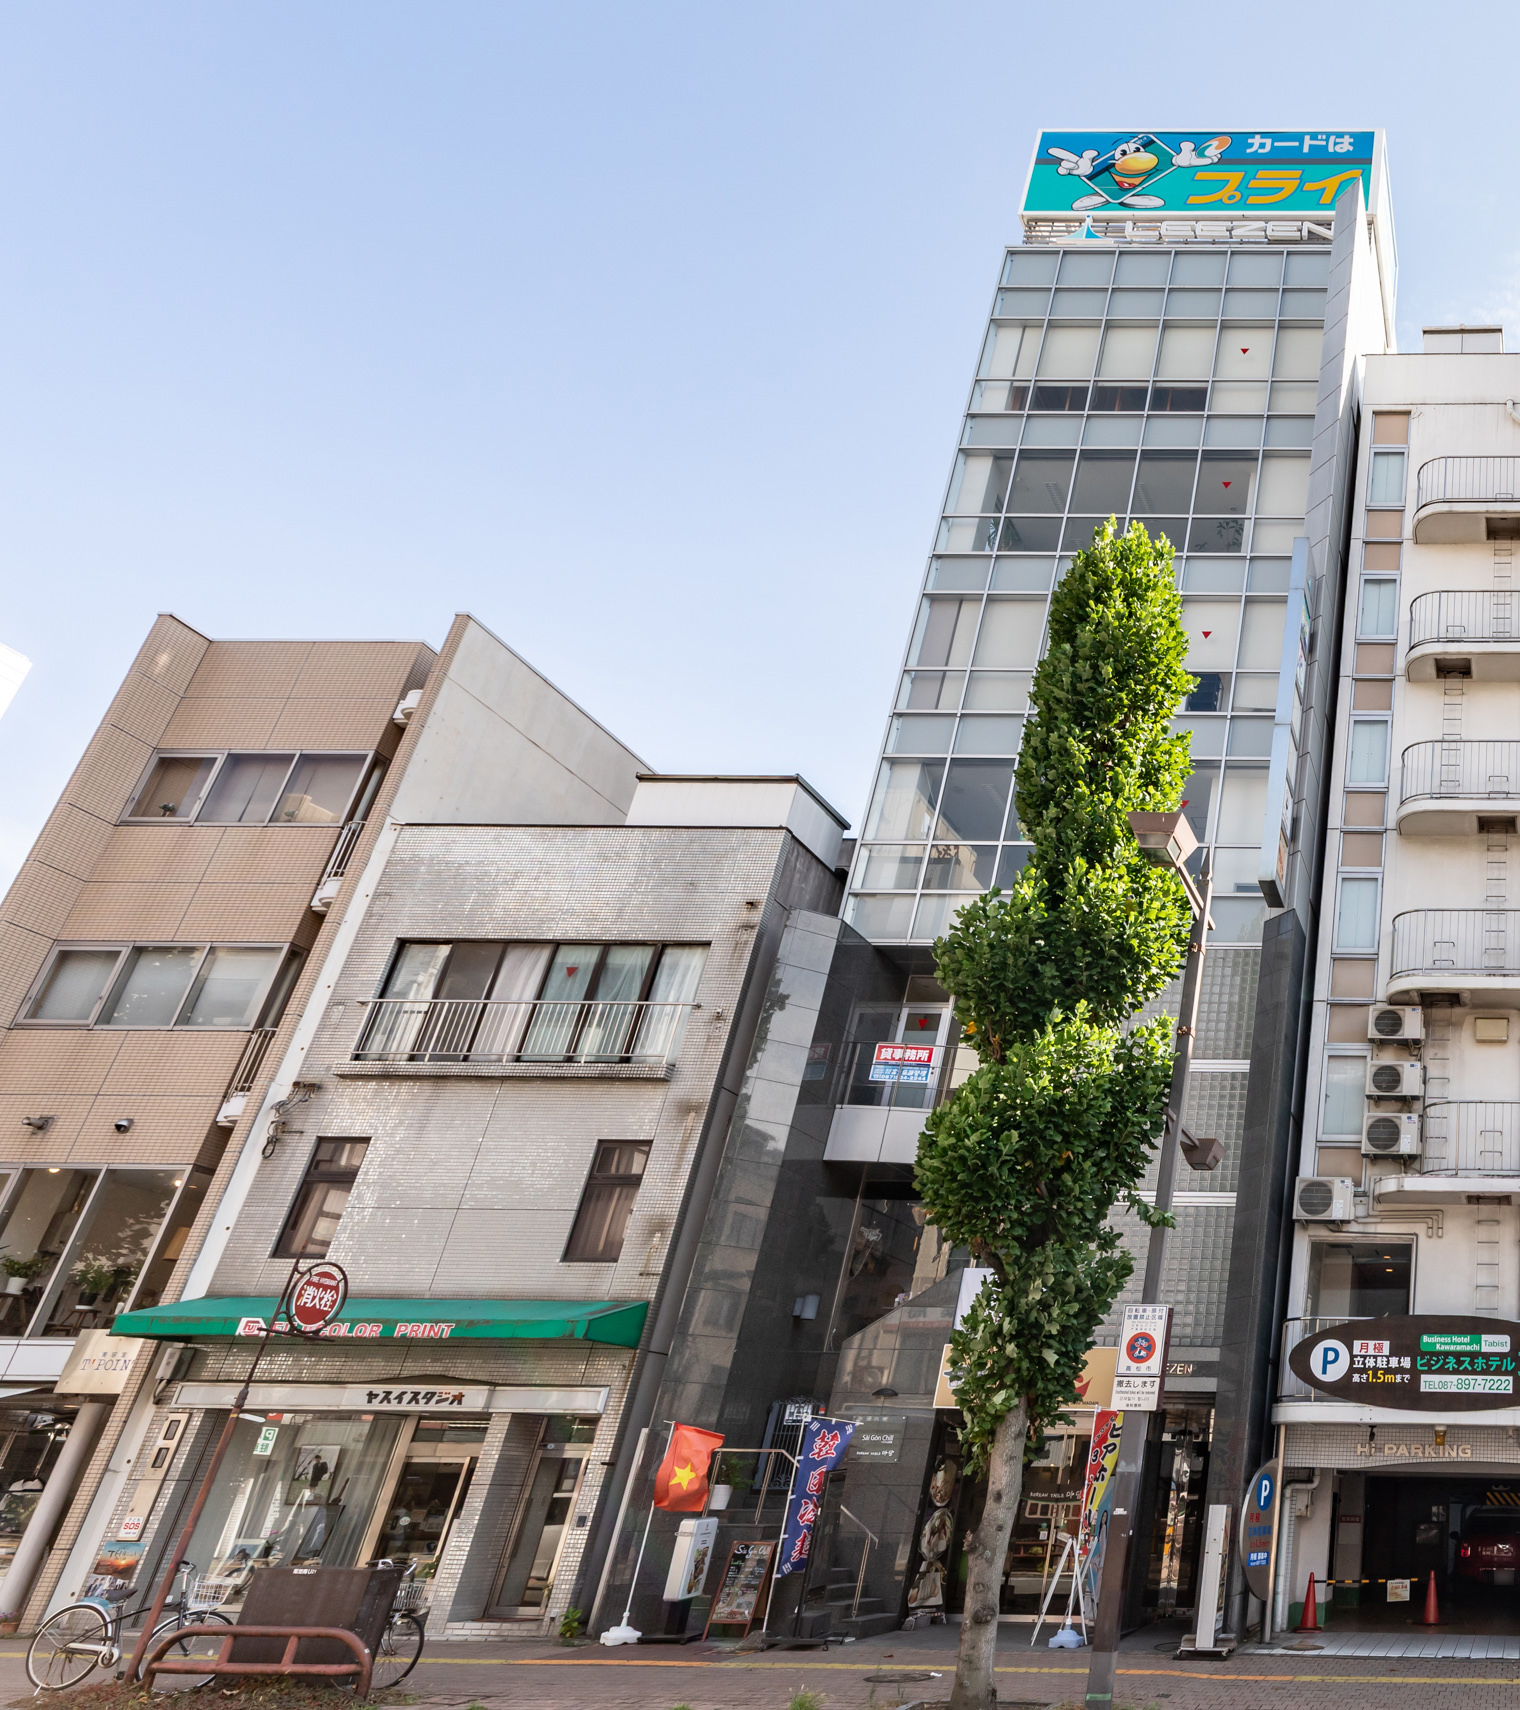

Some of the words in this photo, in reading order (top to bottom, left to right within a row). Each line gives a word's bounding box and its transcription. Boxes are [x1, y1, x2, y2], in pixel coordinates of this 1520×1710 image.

[1246, 134, 1354, 154] カードは
[1184, 169, 1363, 205] プライ
[1124, 220, 1334, 241] LEEZEN
[880, 1047, 930, 1062] 貸事務所
[299, 1285, 337, 1310] 消火栓
[394, 1322, 455, 1338] PRINT
[1423, 1335, 1451, 1344] Business
[1452, 1335, 1470, 1343] Hotel
[1483, 1340, 1508, 1348] Tabist
[1359, 1342, 1384, 1353] 月極
[1436, 1343, 1480, 1351] Kawaramachi
[80, 1358, 134, 1371] T'POIN
[1321, 1347, 1339, 1375] P
[1353, 1356, 1411, 1369] 立体駐車場
[1352, 1370, 1411, 1383] 高さ1.5mまで
[1116, 1380, 1156, 1388] 撤去します
[366, 1390, 465, 1406] ヤスイスタジオ
[1384, 1444, 1472, 1457] PARKING
[122, 1522, 141, 1530] SOS
